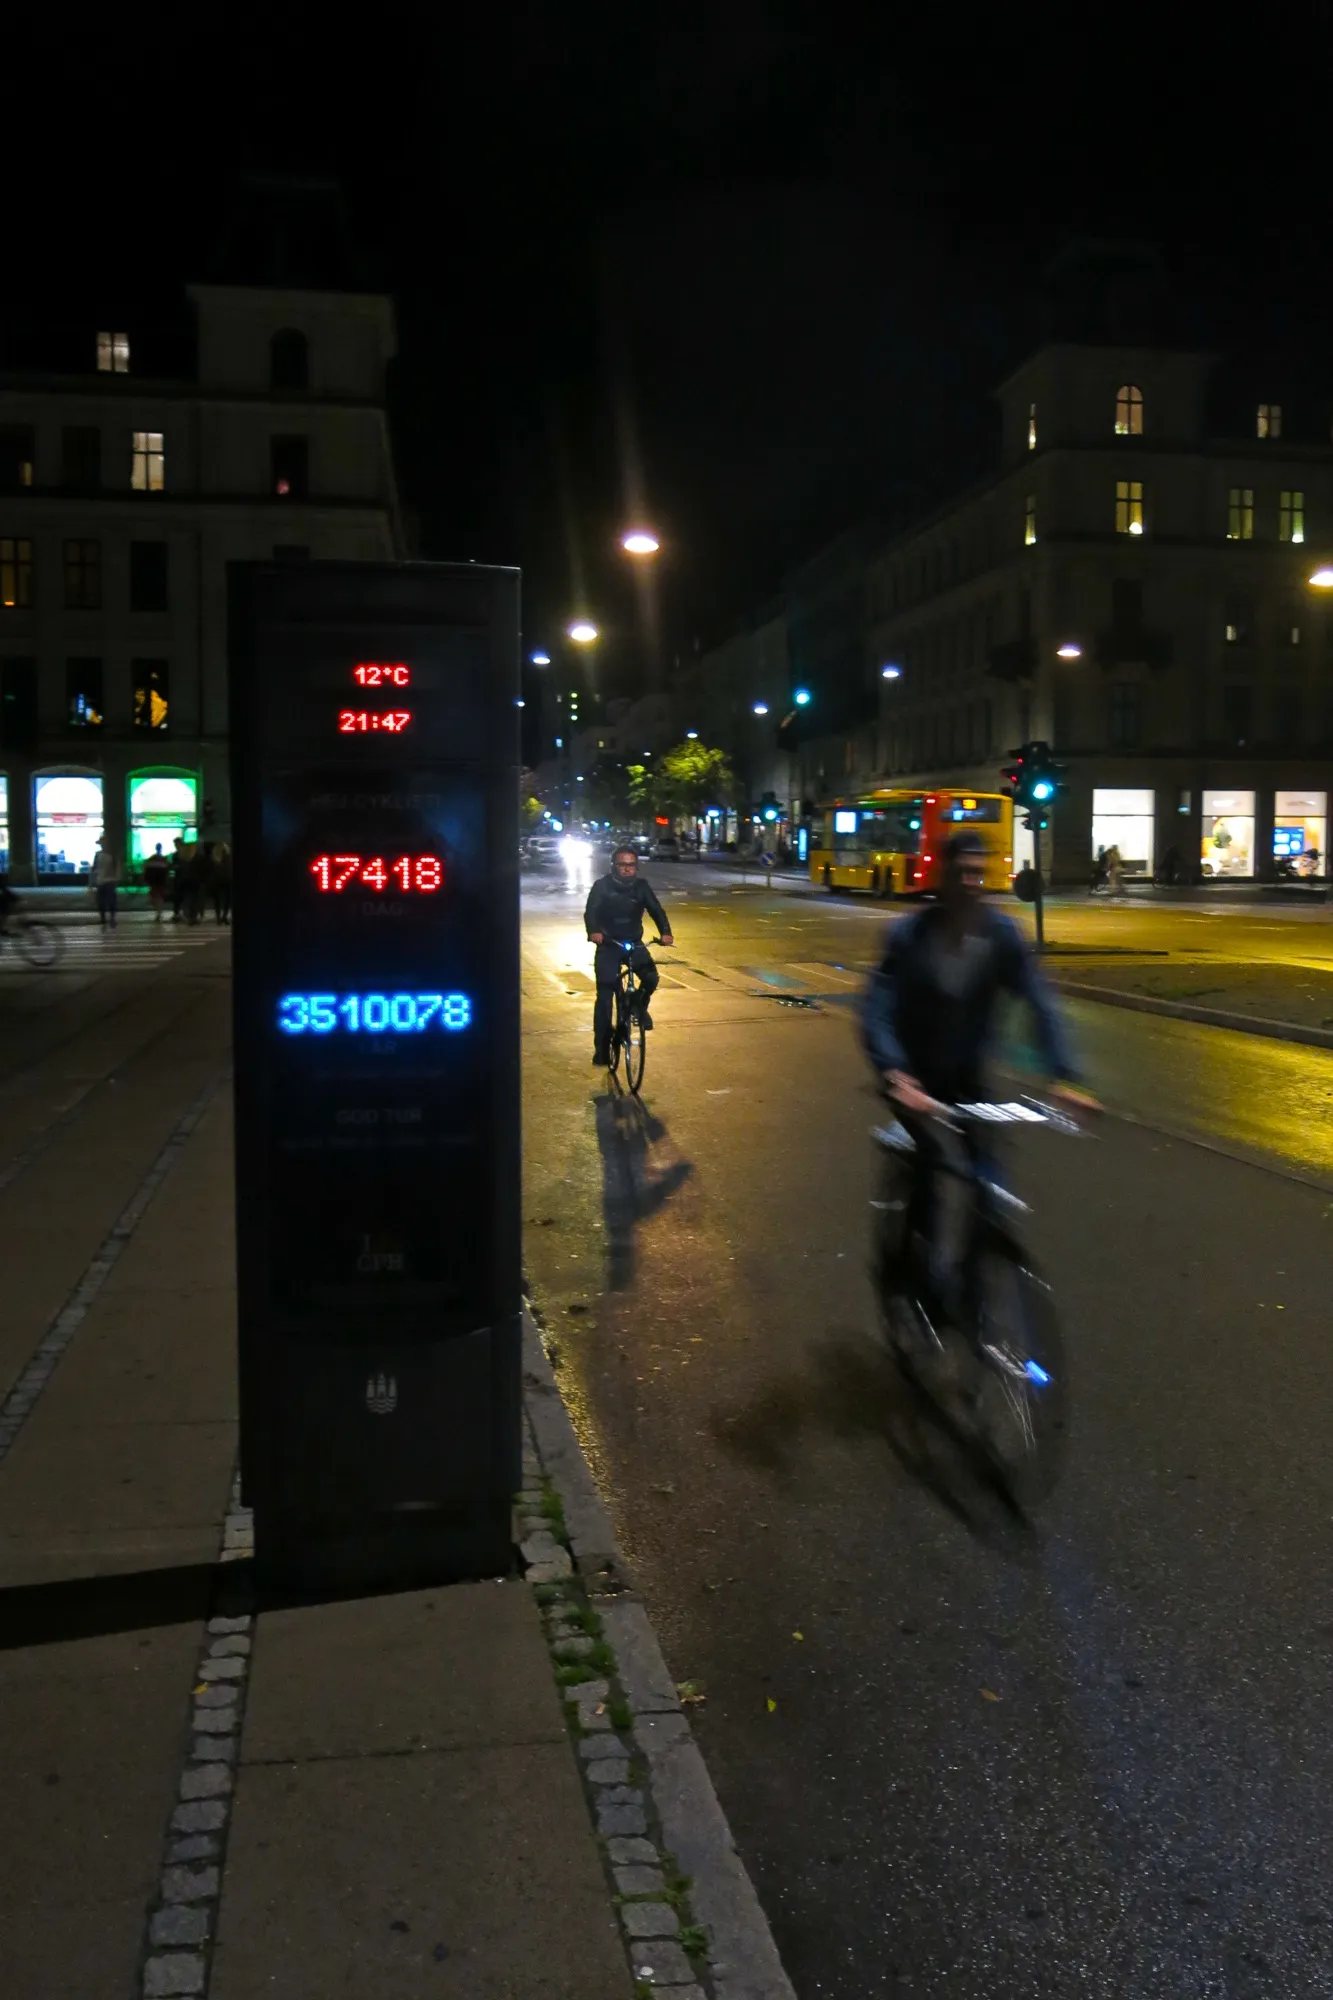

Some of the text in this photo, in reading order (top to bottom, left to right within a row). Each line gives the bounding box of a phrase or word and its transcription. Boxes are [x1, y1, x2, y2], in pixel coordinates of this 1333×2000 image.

[354, 665, 410, 686] 12°C
[339, 711, 411, 732] 21:47
[311, 856, 442, 890] 17418
[361, 901, 404, 917] DAG
[280, 993, 471, 1031] 3510078
